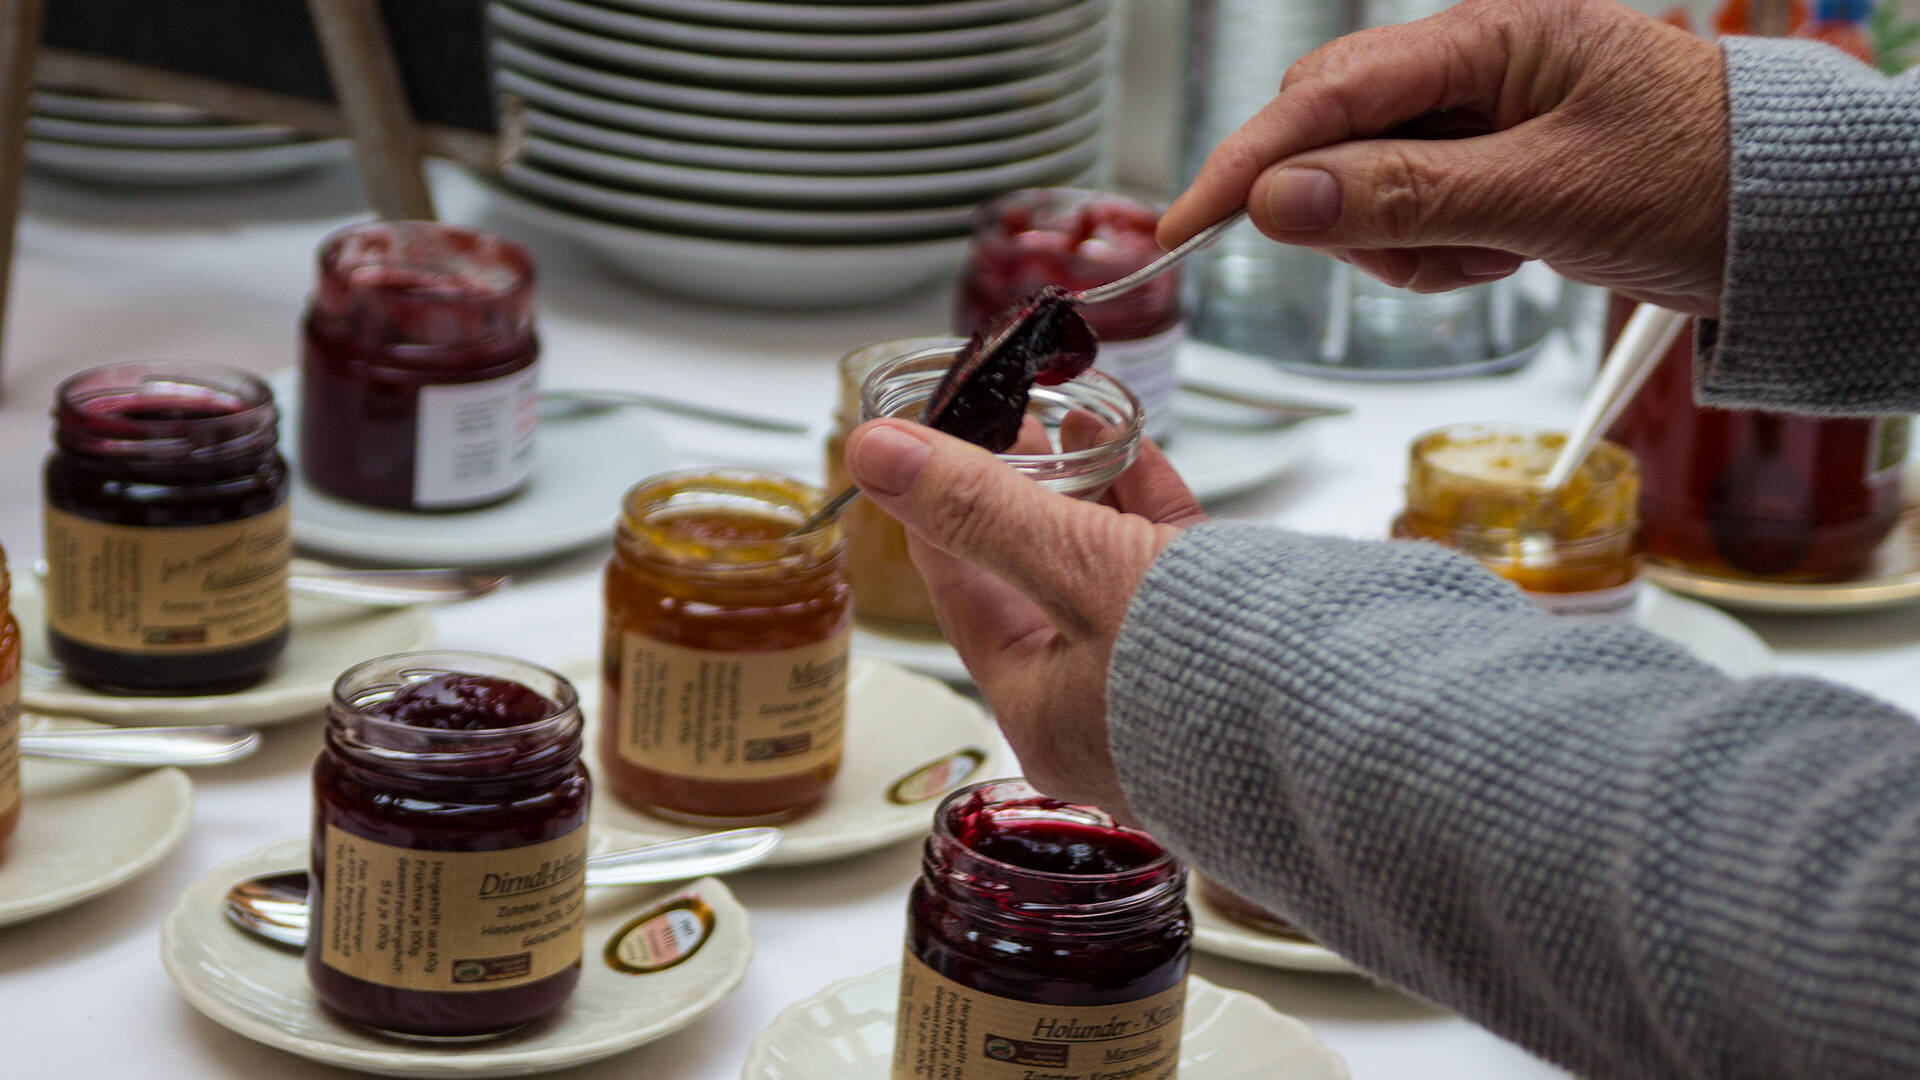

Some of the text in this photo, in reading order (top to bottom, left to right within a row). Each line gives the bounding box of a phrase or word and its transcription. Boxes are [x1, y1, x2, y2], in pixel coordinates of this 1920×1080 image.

[427, 860, 444, 927] Hergestellt
[957, 997, 973, 1064] Hergestellt
[1032, 1016, 1131, 1039] Holunder
